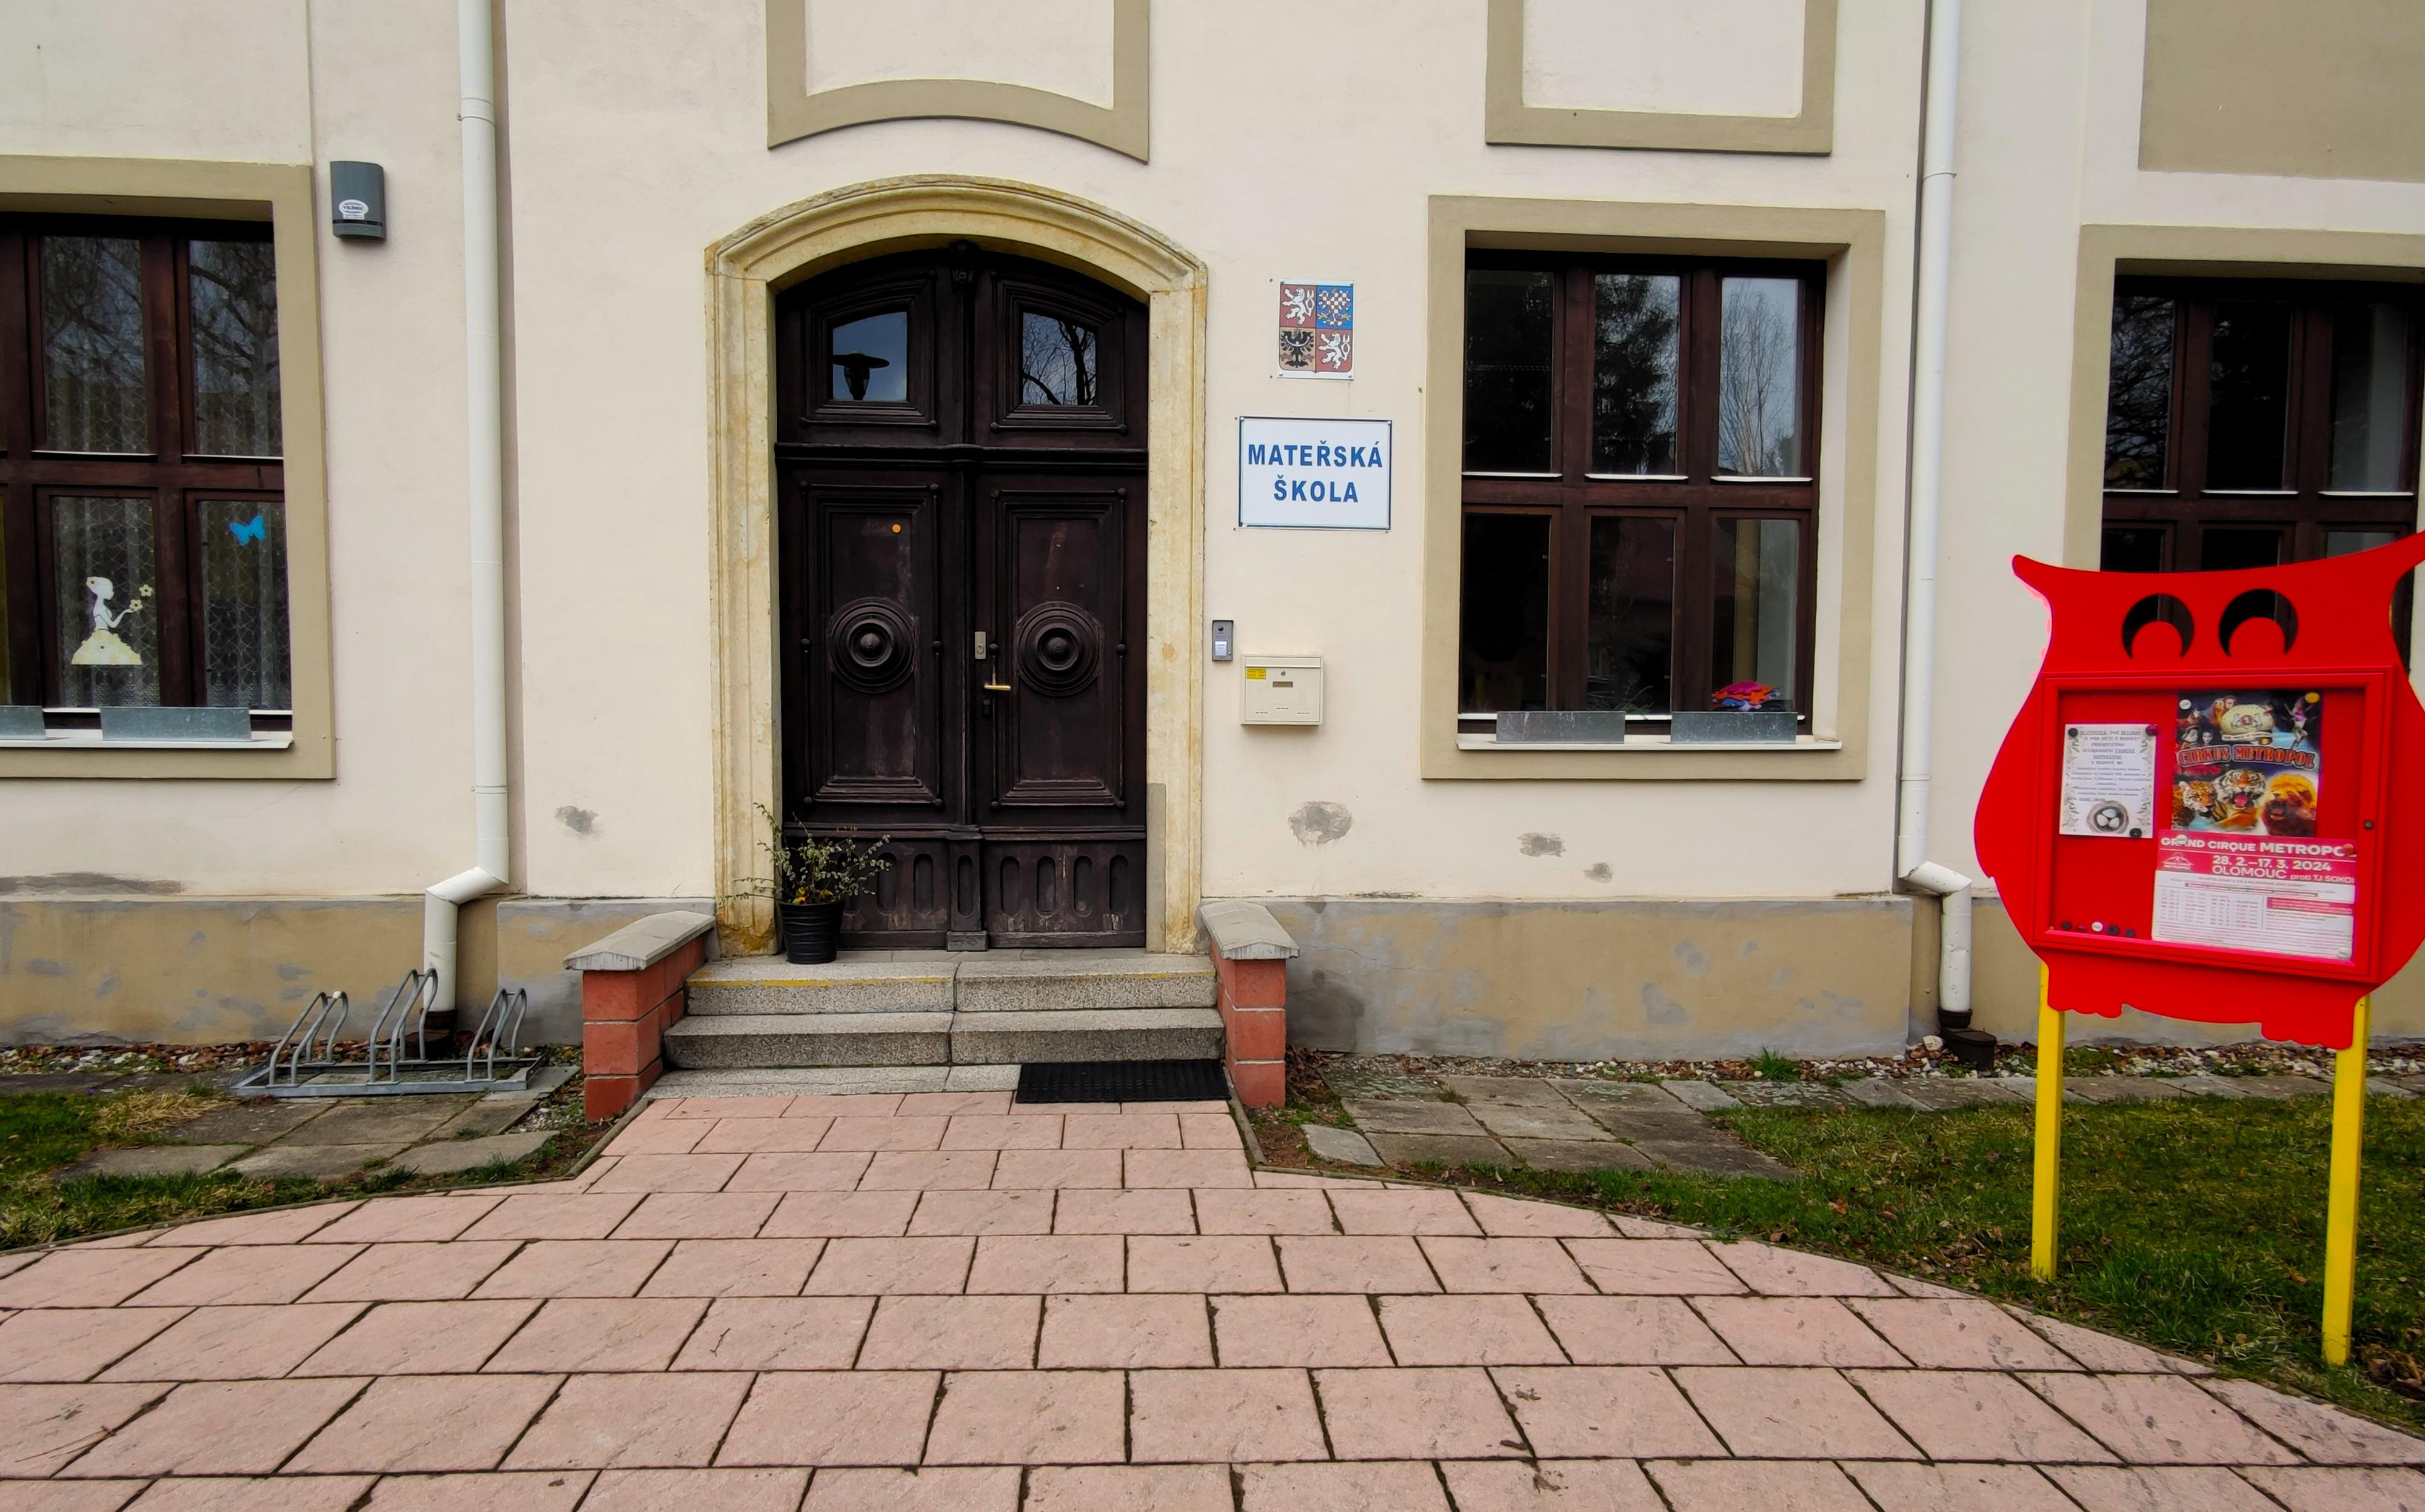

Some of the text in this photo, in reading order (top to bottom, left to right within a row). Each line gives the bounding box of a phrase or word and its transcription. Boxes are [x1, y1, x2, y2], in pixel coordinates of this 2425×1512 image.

[1248, 440, 1383, 467] MATEŘSKÁ
[1274, 475, 1359, 503] ŠKOLA
[2179, 746, 2316, 768] CIRKUS METROPOL
[2208, 841, 2256, 852] CIRQUE
[2259, 842, 2356, 857] METROPO
[2212, 865, 2287, 879] OLOMOUC
[2213, 855, 2232, 865] 28.
[2276, 860, 2289, 869] 3.
[2292, 860, 2332, 871] 2024
